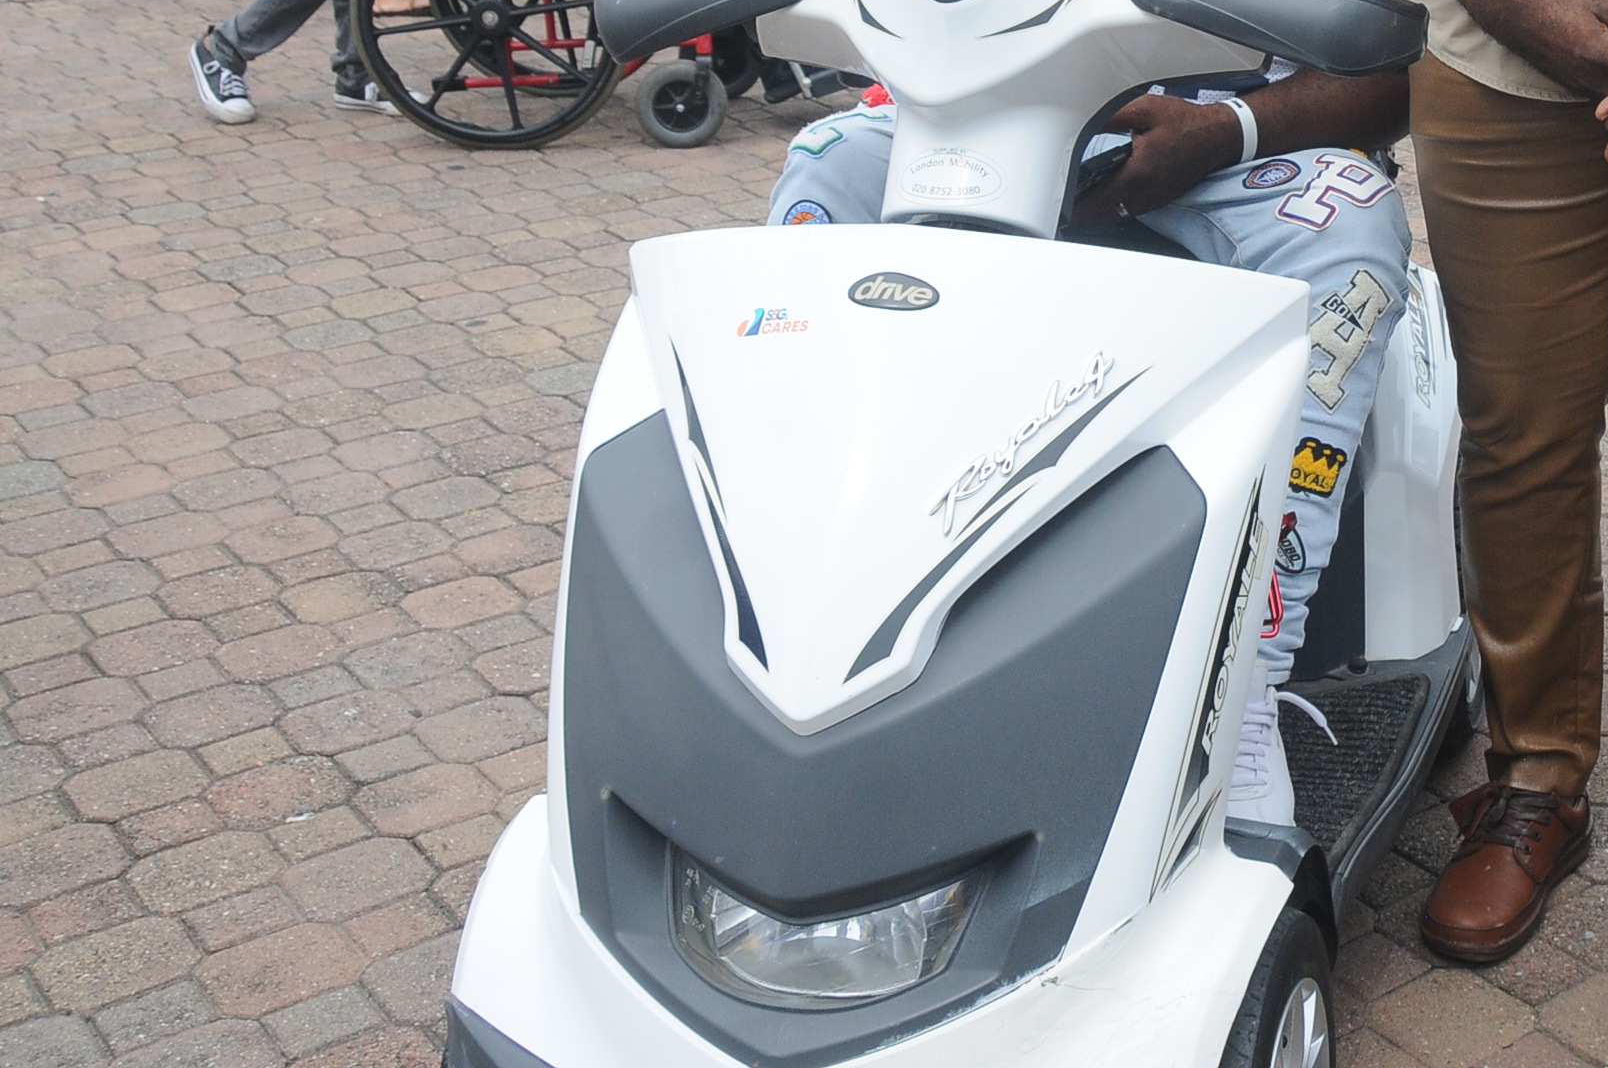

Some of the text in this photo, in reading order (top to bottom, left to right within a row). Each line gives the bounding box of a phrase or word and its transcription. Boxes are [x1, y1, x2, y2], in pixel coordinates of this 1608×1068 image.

[911, 157, 990, 178] London Mobility
[911, 183, 981, 197] 020 8752 3080
[854, 276, 934, 305] drive
[761, 320, 809, 335] CARES
[1291, 467, 1328, 489] OYAL
[1201, 512, 1264, 756] ROYALE
